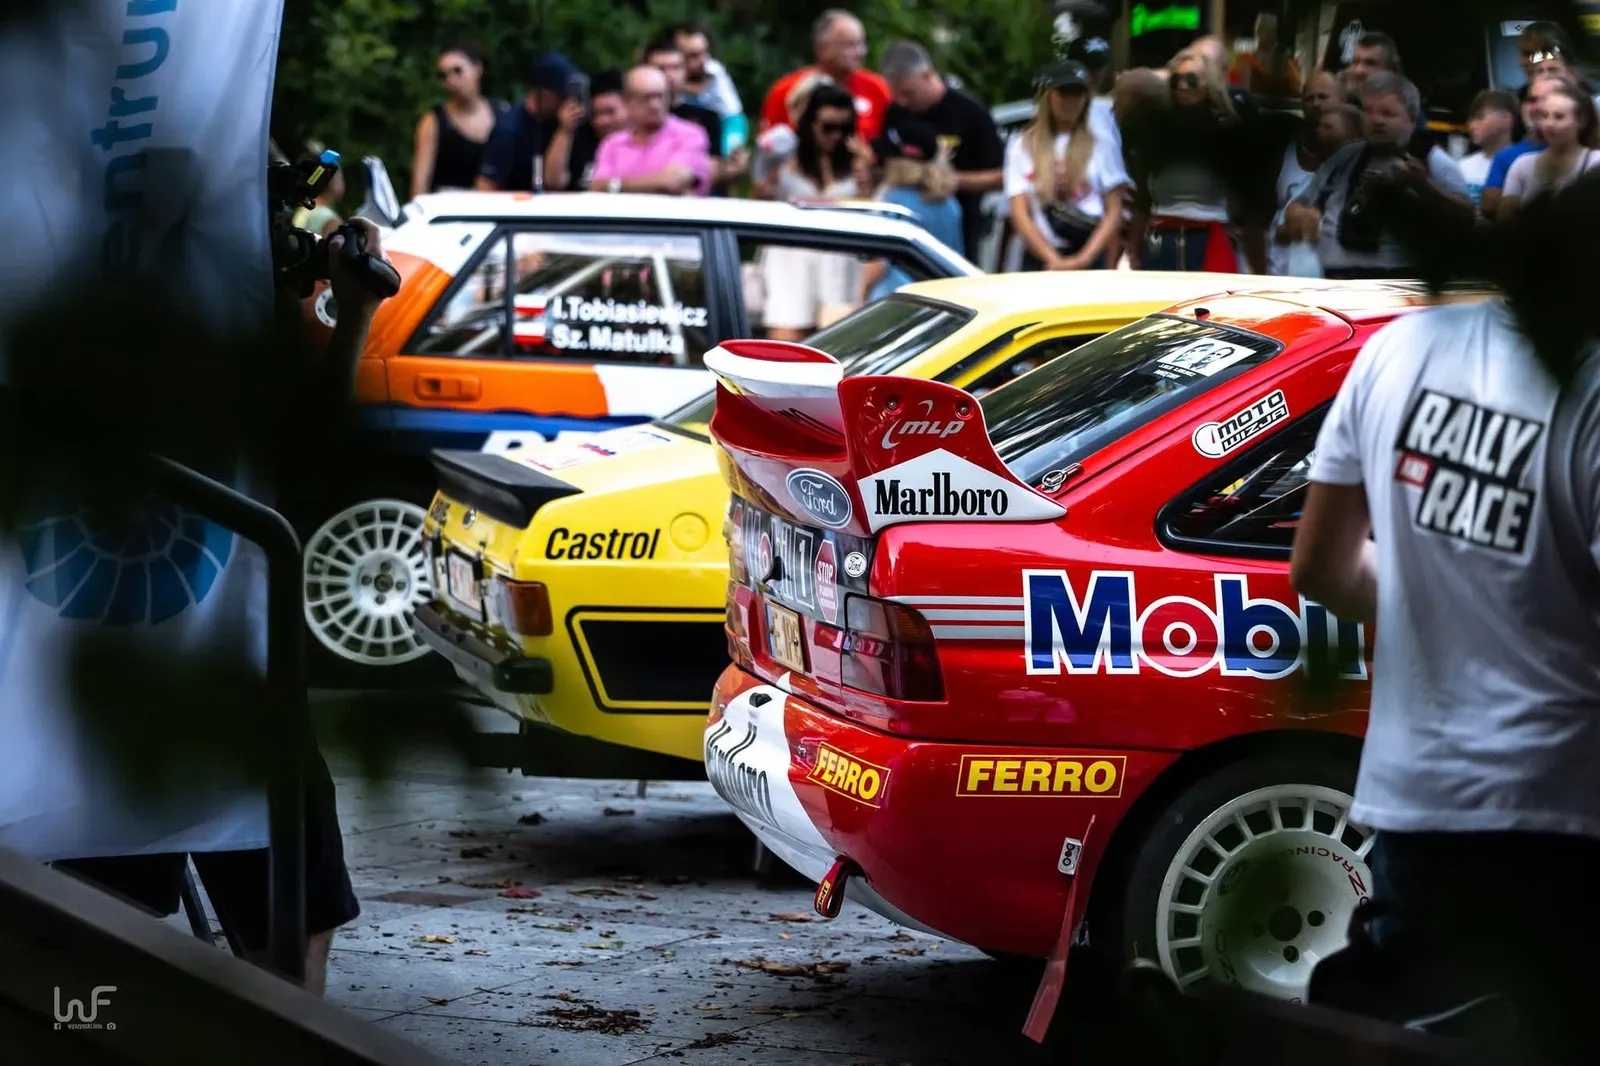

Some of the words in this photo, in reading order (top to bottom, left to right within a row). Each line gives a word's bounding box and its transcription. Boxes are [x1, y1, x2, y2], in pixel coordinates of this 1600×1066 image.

[1217, 391, 1284, 439] MOTO
[1222, 405, 1286, 451] WIZJA
[1405, 392, 1541, 478] RALLY
[799, 481, 838, 517] Ford
[874, 472, 1009, 516] Marlboro
[1419, 468, 1530, 549] RACE
[545, 527, 661, 560] Castrol
[816, 561, 835, 585] STOP
[813, 748, 881, 800] FERRO
[966, 760, 1117, 793] FERRO
